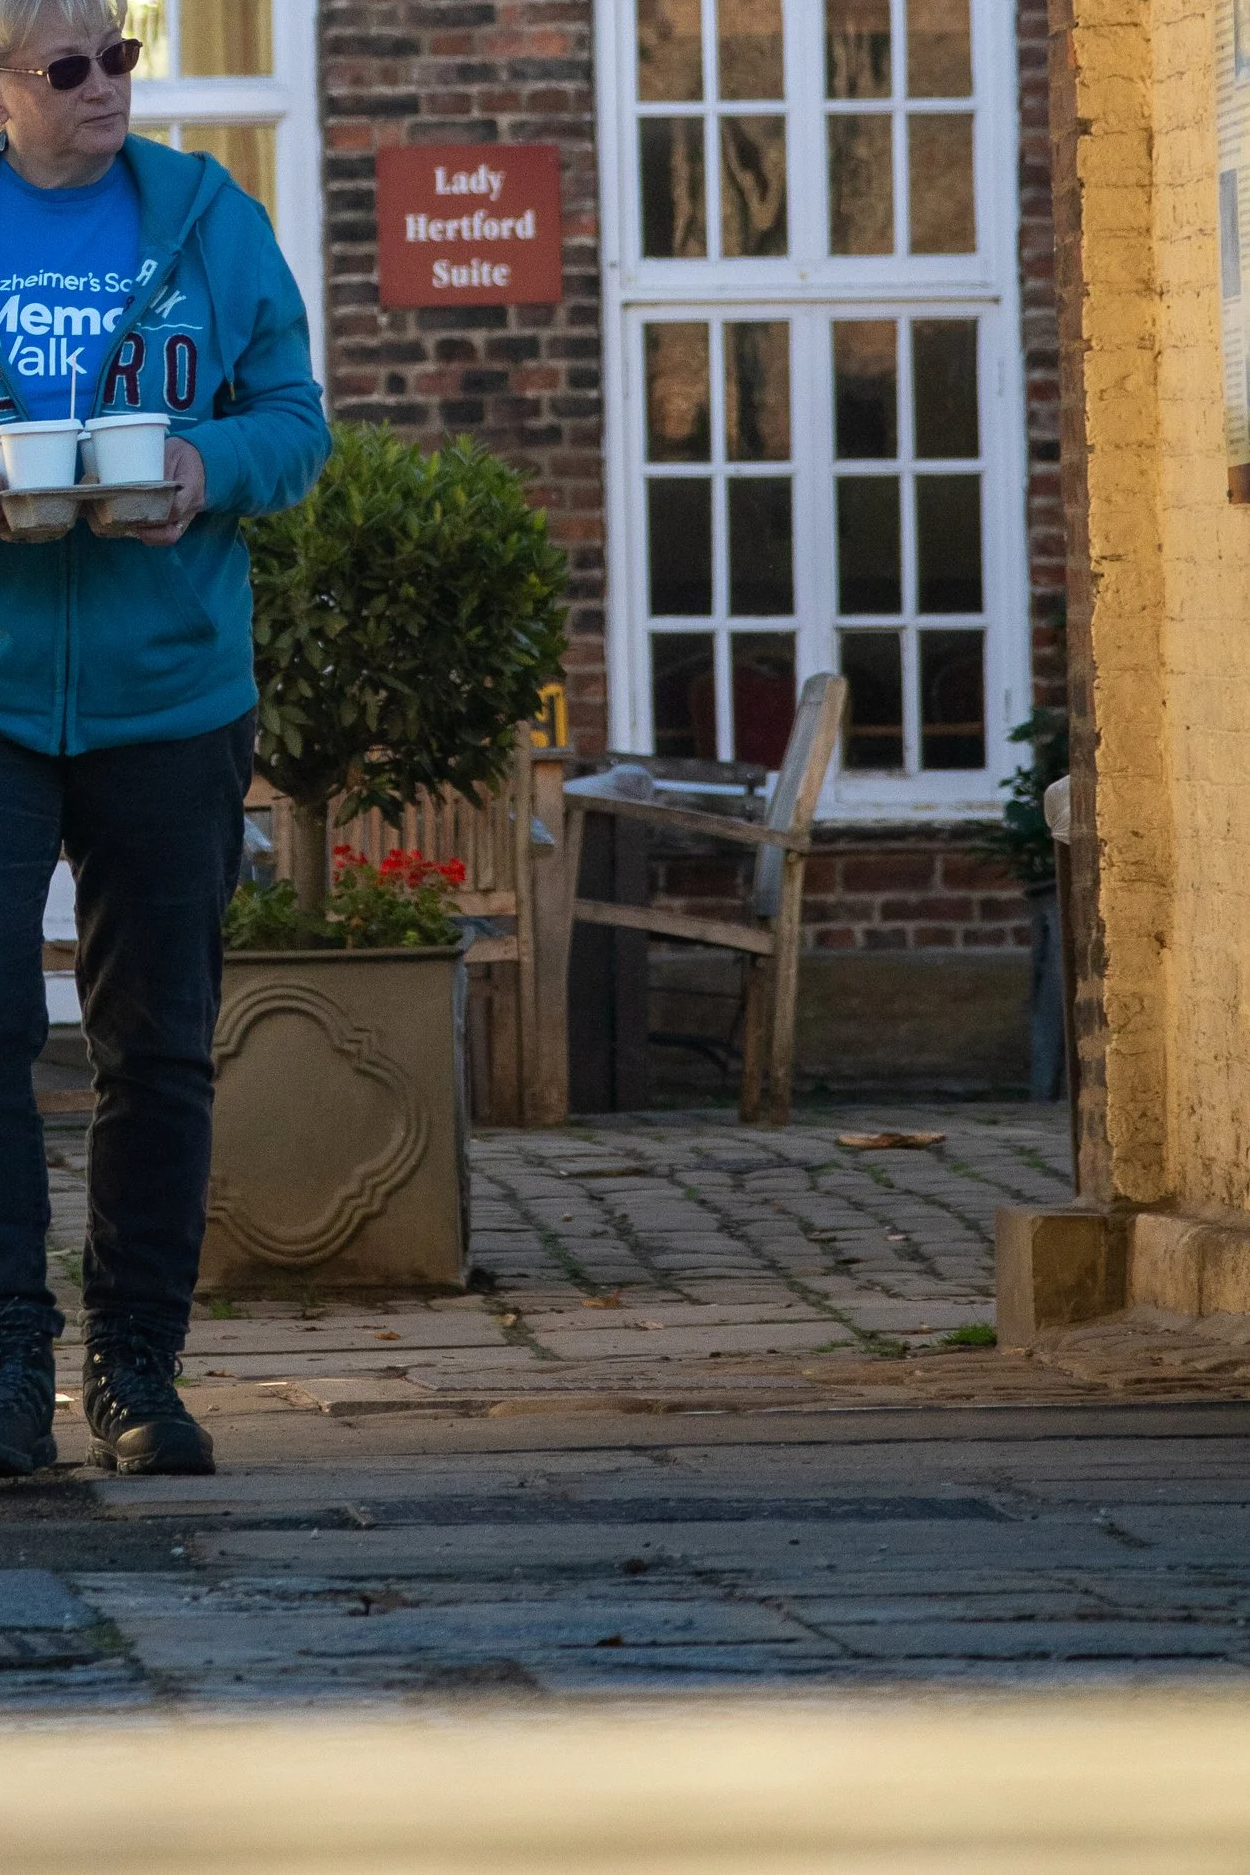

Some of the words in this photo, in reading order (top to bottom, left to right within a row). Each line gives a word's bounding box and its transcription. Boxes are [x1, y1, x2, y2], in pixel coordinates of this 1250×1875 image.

[433, 164, 506, 202] Lady
[405, 209, 537, 242] Hertford
[432, 258, 512, 289] Suite
